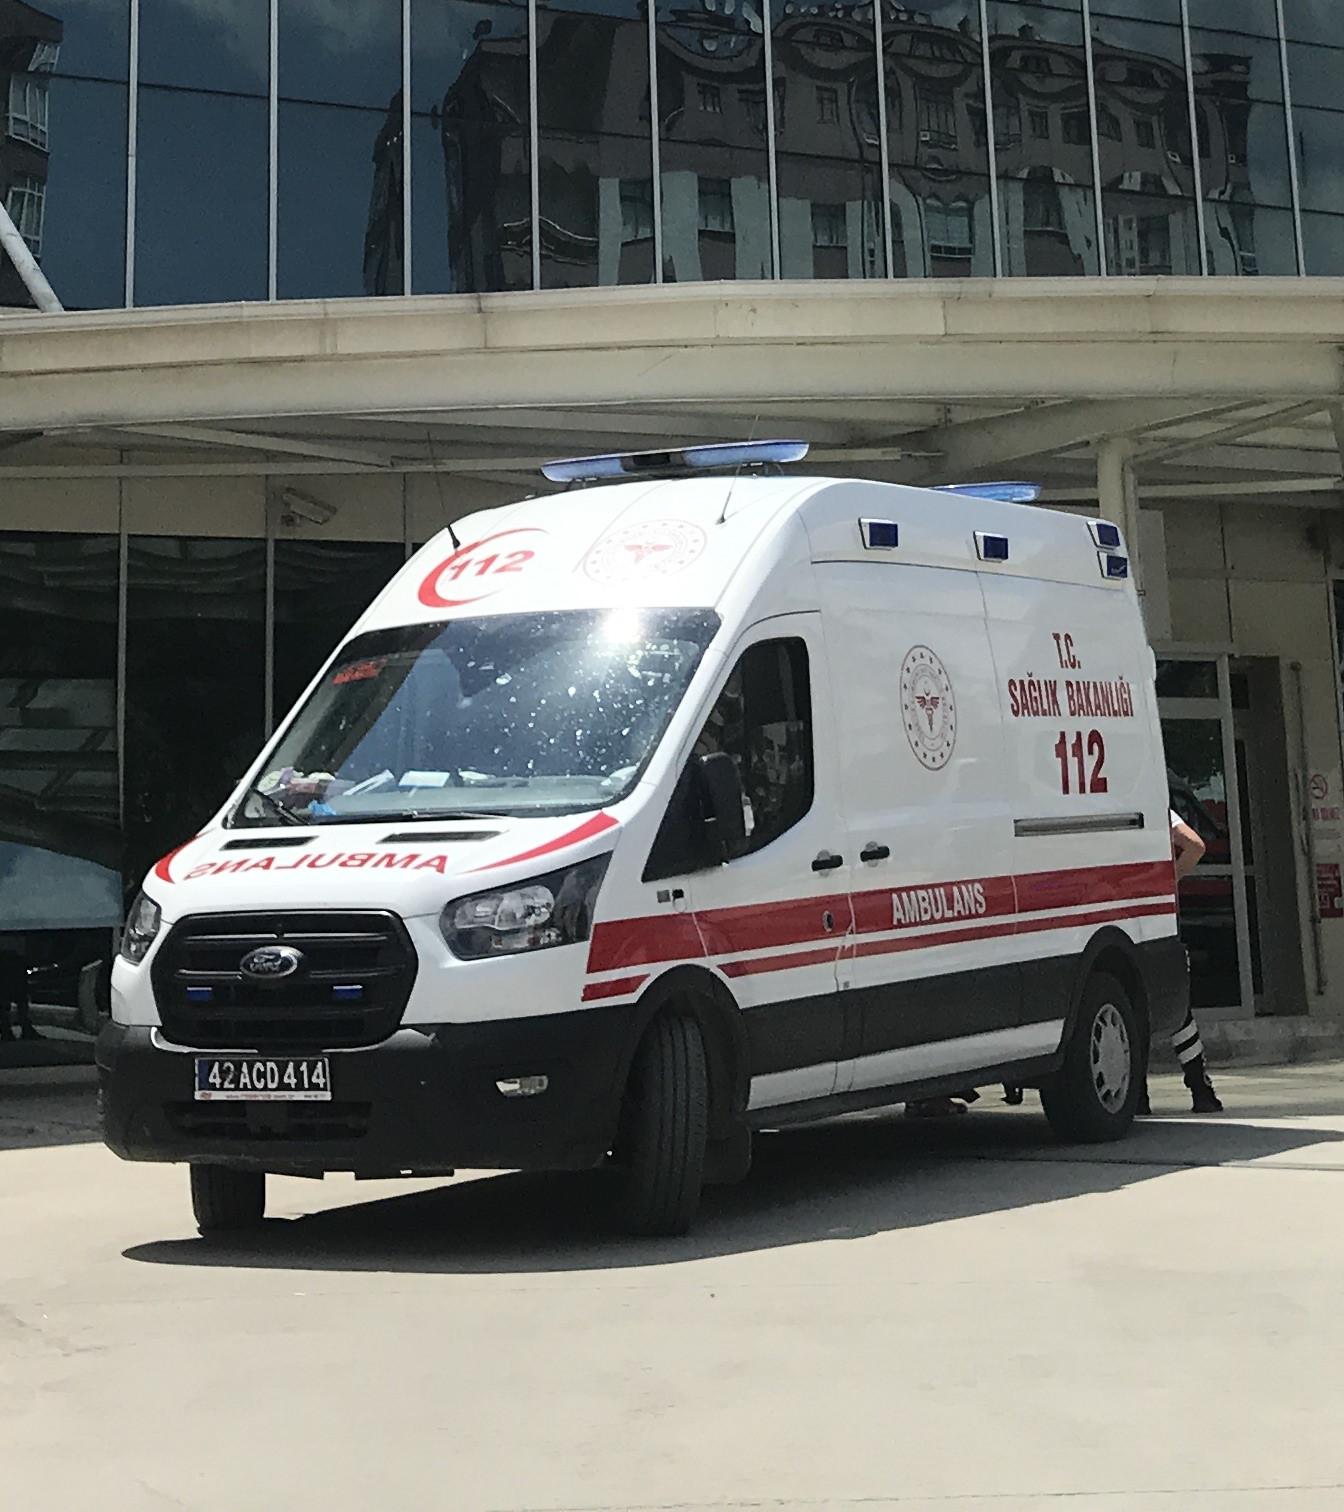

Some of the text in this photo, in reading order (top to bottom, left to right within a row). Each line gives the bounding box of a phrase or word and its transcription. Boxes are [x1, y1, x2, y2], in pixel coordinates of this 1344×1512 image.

[447, 549, 536, 582] 112
[1051, 631, 1082, 670] T.C.
[1007, 671, 1134, 718] SAĞLIK BAKANLIĞI
[1054, 728, 1109, 795] 112
[891, 881, 987, 926] AMBULANS
